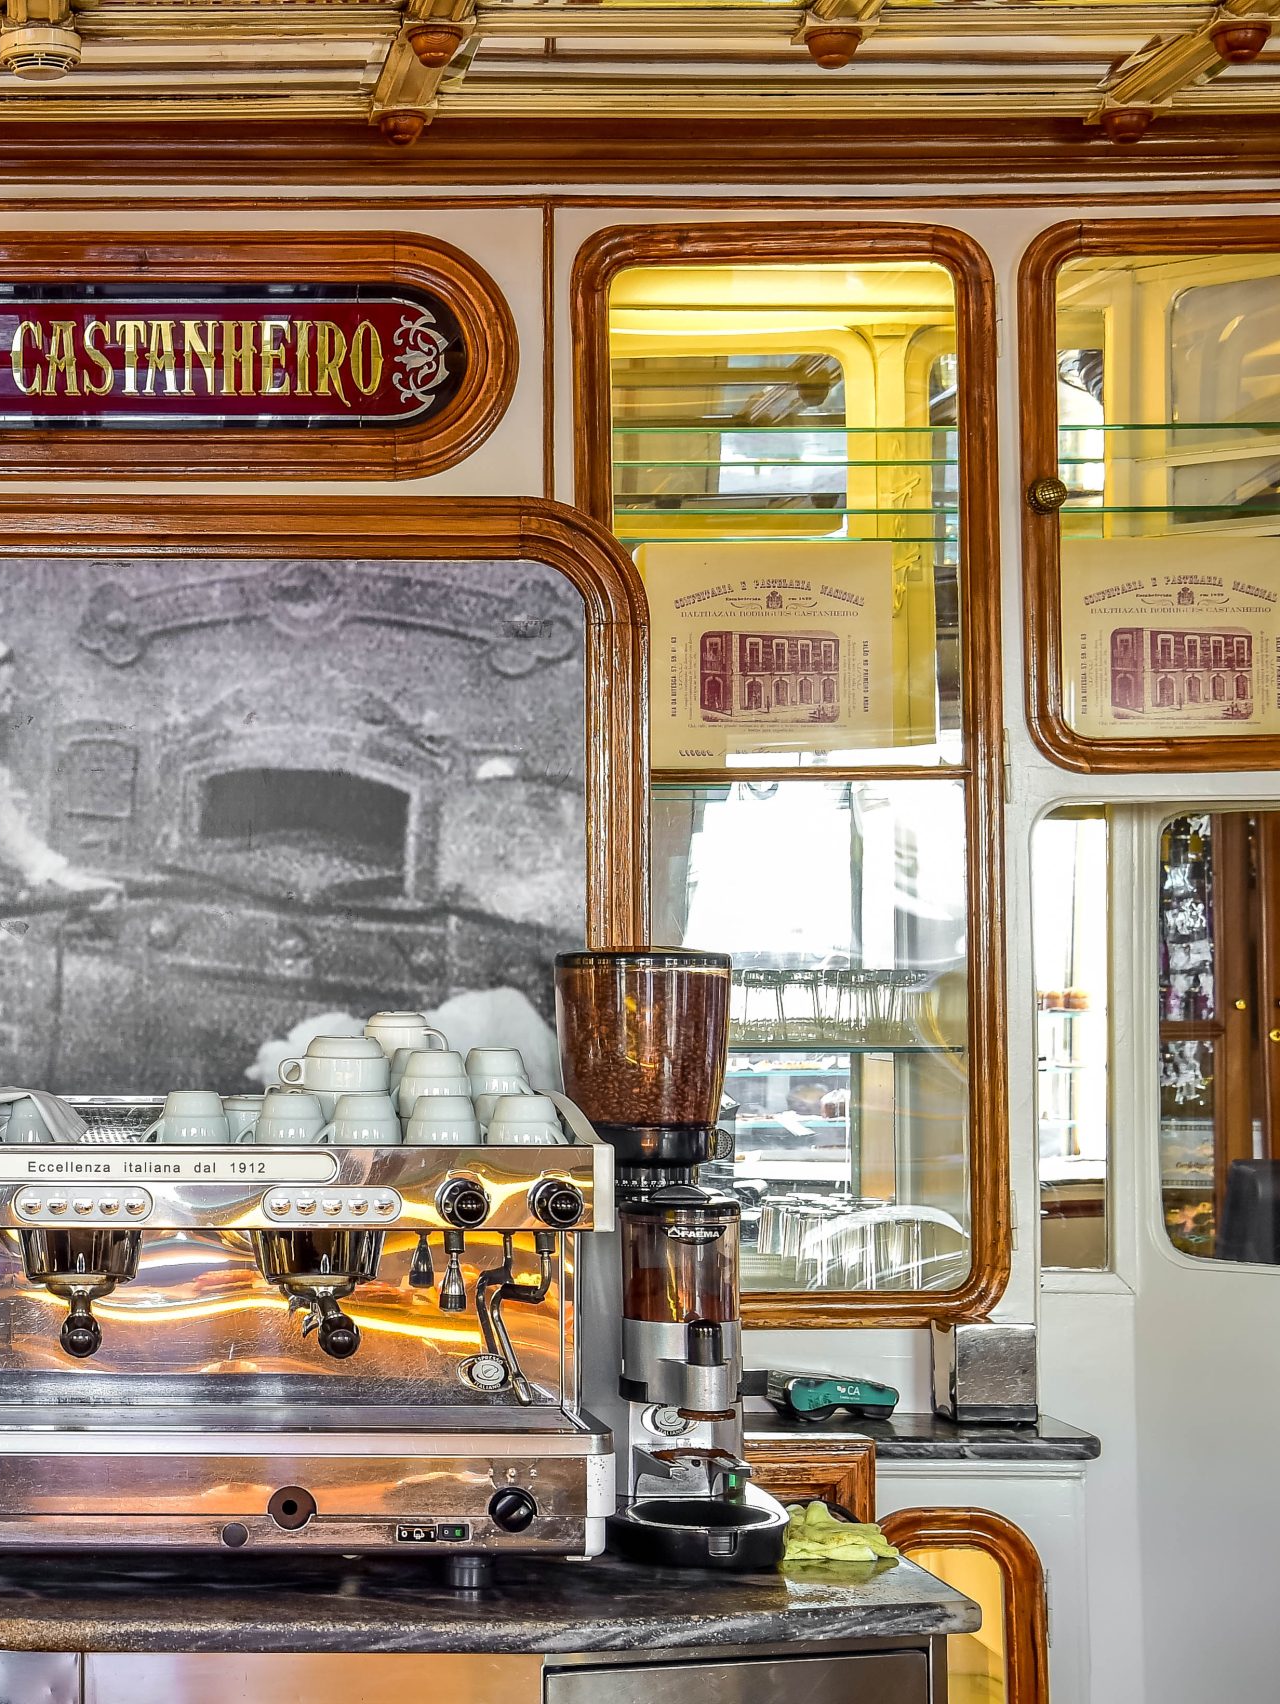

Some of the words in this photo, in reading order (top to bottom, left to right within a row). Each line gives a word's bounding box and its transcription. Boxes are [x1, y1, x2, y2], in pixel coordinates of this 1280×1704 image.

[10, 319, 384, 407] CASTANHEIRO
[27, 1161, 111, 1174] Eccellenza
[123, 1161, 181, 1174] italiana
[193, 1161, 216, 1174] dal
[229, 1162, 266, 1174] 1912
[680, 1230, 720, 1238] FAEMA
[473, 1381, 501, 1390] ITALIANO
[847, 1385, 861, 1396] CA
